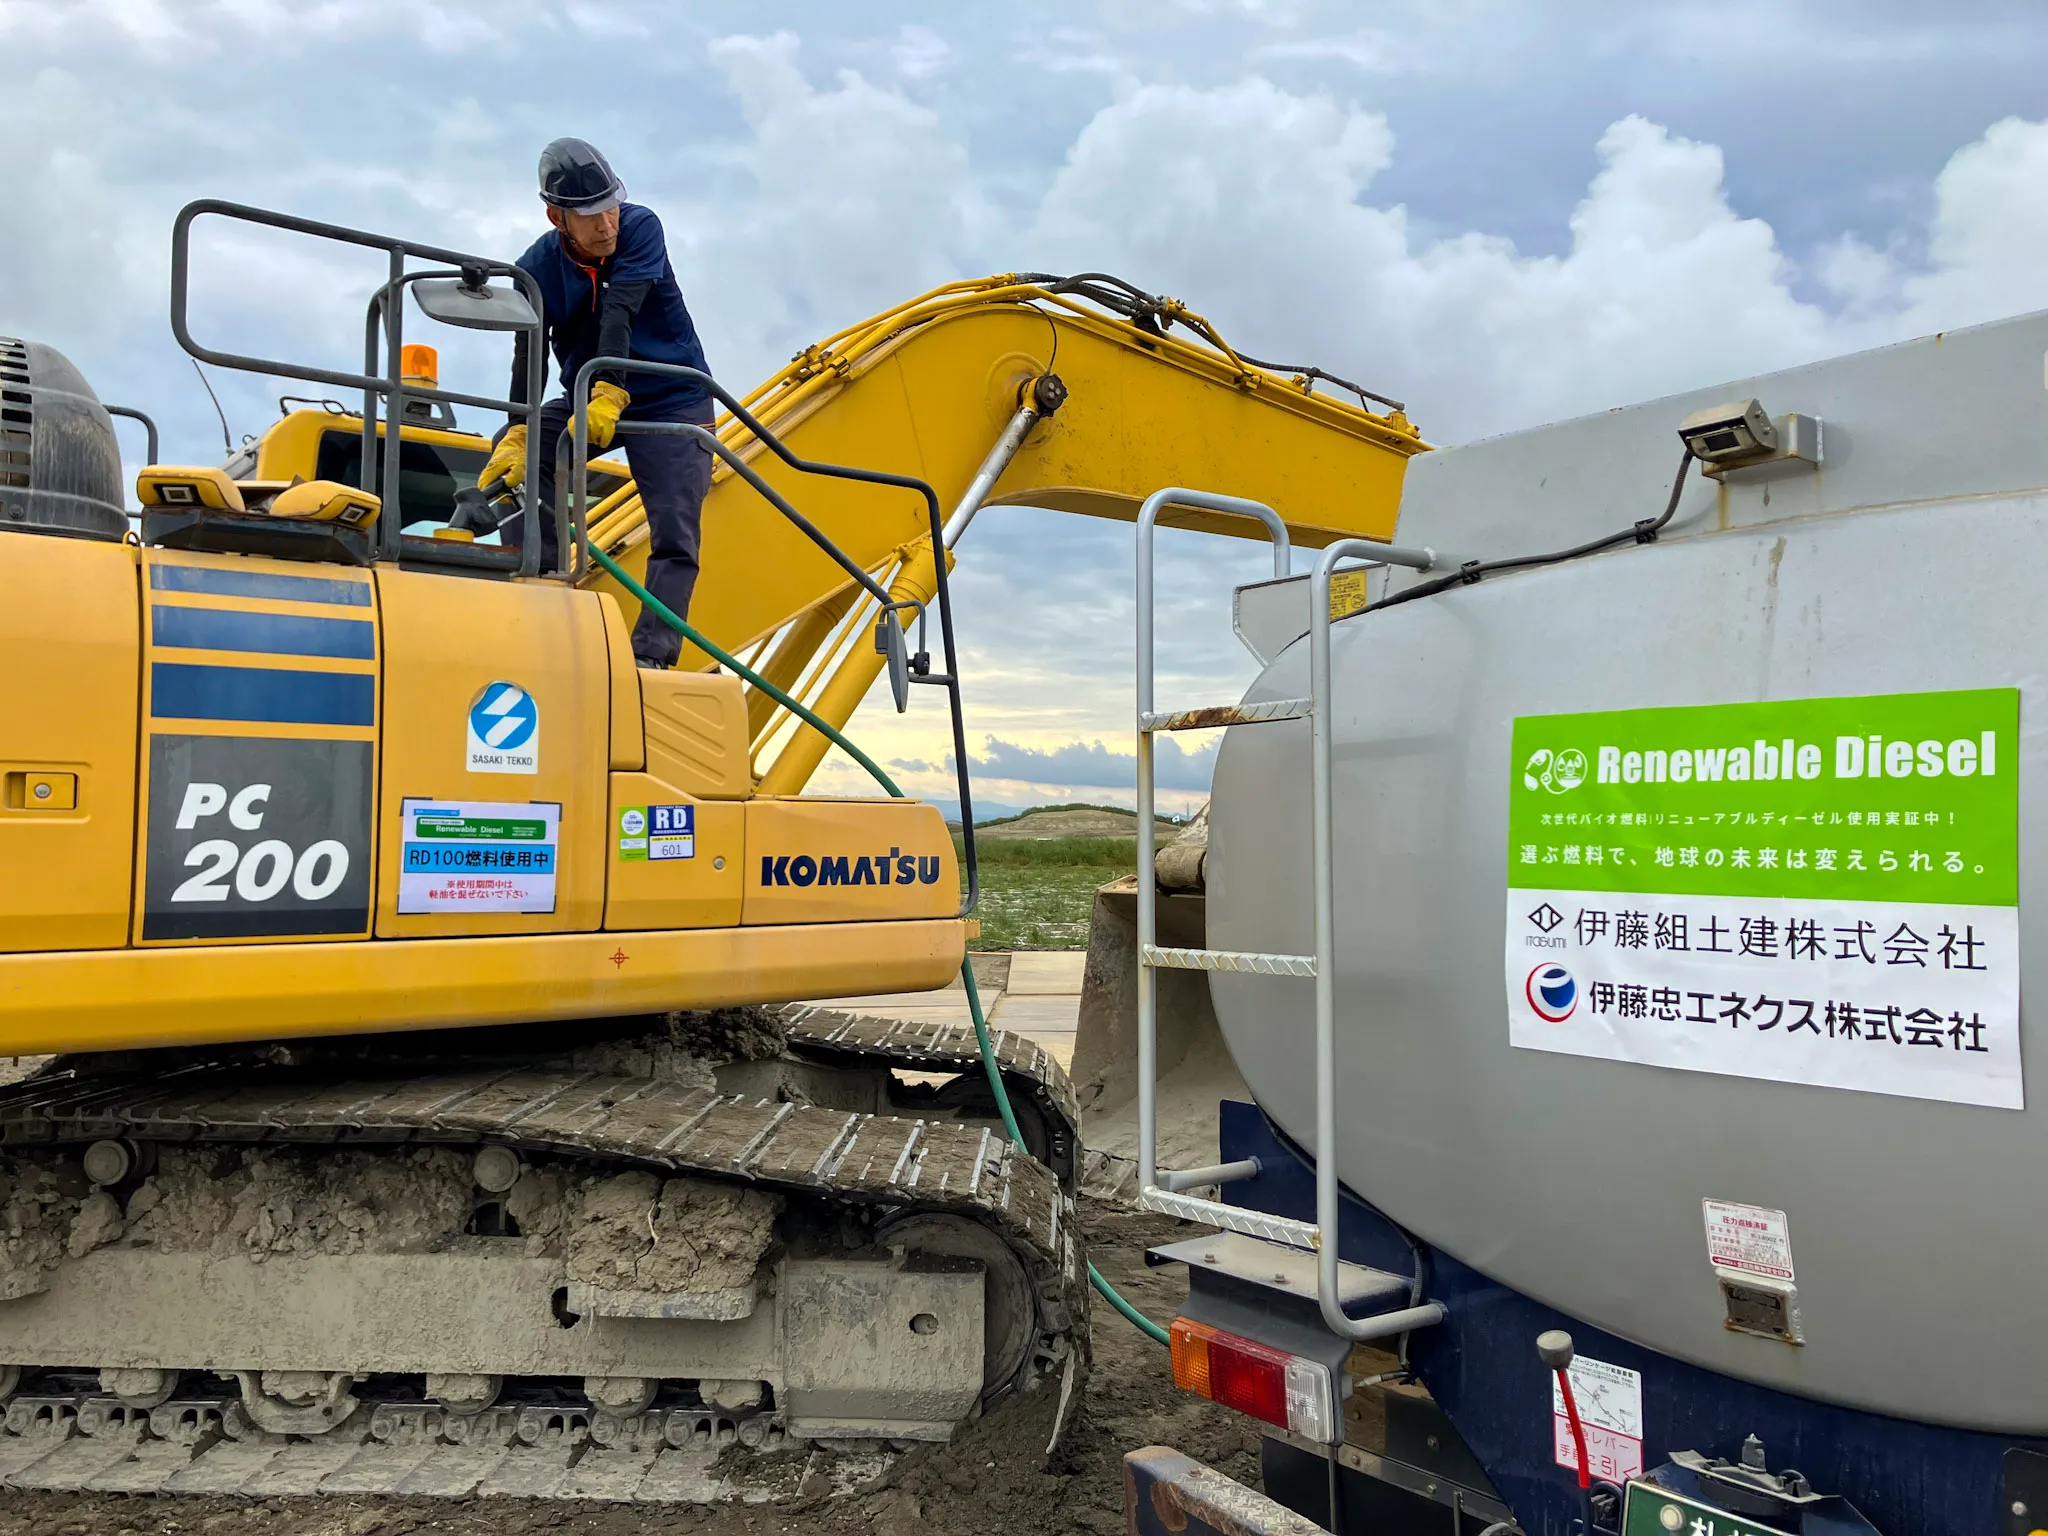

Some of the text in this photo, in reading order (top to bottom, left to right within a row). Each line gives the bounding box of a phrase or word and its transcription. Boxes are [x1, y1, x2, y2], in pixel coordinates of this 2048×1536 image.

[472, 754, 533, 765] SASAKI TEKKO
[1597, 730, 1996, 784] Renewable Diesel
[176, 782, 272, 830] PC
[655, 808, 687, 829] RD
[436, 824, 477, 833] Renewable
[480, 825, 504, 834] Diesel
[410, 850, 549, 867] RD100燃料使用中
[662, 844, 682, 856] 601
[761, 847, 940, 887] KOMATSU
[171, 839, 350, 902] 200
[1574, 908, 1988, 971] 伊藤組土建株式会社
[1589, 980, 1989, 1053] 伊藤忠エネクス株式会社
